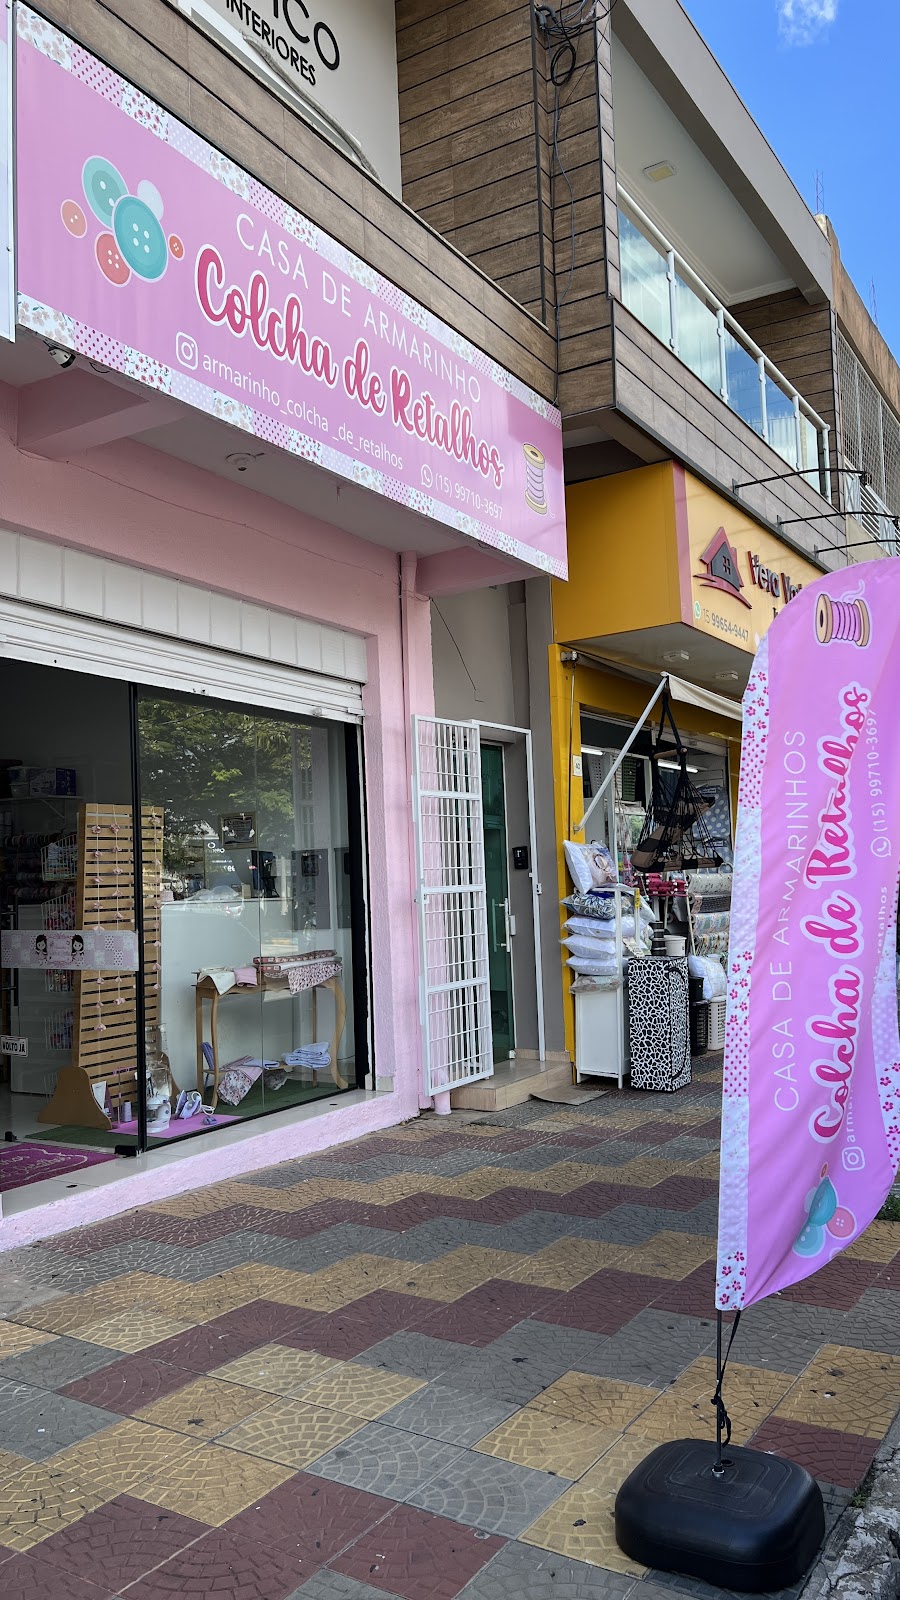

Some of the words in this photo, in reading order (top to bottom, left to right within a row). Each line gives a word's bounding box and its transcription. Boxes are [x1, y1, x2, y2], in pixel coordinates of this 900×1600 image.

[236, 213, 309, 290] CASA
[322, 270, 352, 318] DE
[363, 303, 481, 403] ARMARINHO
[196, 245, 338, 388] Colcha
[344, 339, 386, 415] de
[391, 367, 504, 489] Retalhos
[203, 354, 329, 432] armarinho_colcha
[435, 472, 453, 498] (15)
[454, 482, 503, 521] 99710-3697
[747, 550, 780, 598] Vera
[702, 608, 710, 624] 15
[772, 730, 809, 946] ARMARINHOS
[871, 802, 888, 832] (15)
[803, 892, 862, 956] de
[769, 960, 792, 1002] DE
[771, 1017, 800, 1112] CASA
[808, 967, 862, 1140] Colcha
